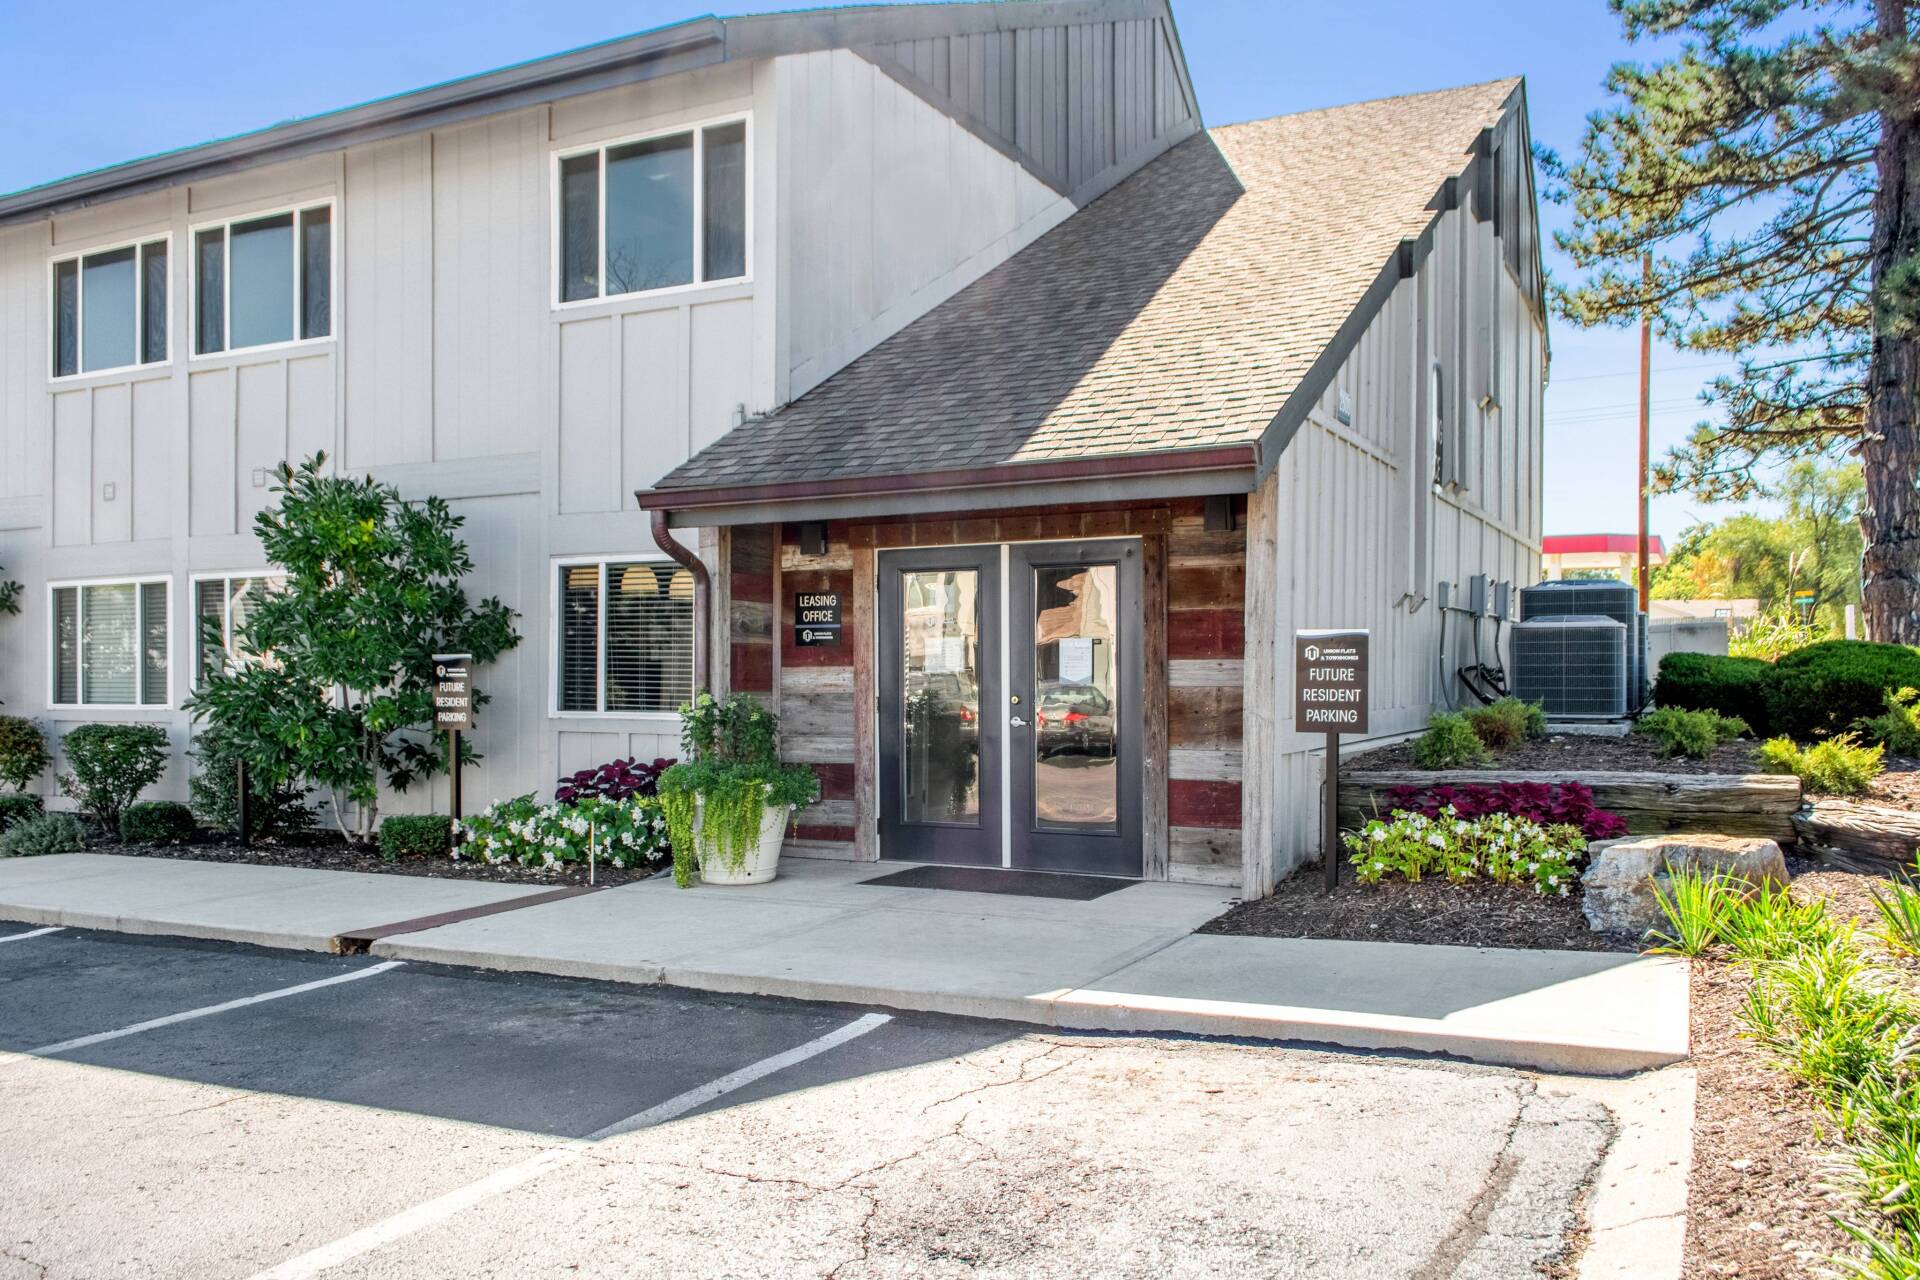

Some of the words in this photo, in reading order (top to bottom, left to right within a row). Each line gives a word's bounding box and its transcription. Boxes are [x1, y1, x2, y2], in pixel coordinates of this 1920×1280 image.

[799, 595, 837, 607] LEASING
[803, 610, 833, 622] OFFICE
[1309, 668, 1355, 681] FUTURE
[439, 682, 464, 692] FUTURE
[1303, 688, 1361, 702] RESIDENT
[436, 697, 468, 707] RESIDENT
[437, 712, 467, 722] PARKING
[1305, 709, 1358, 723] PARKING
